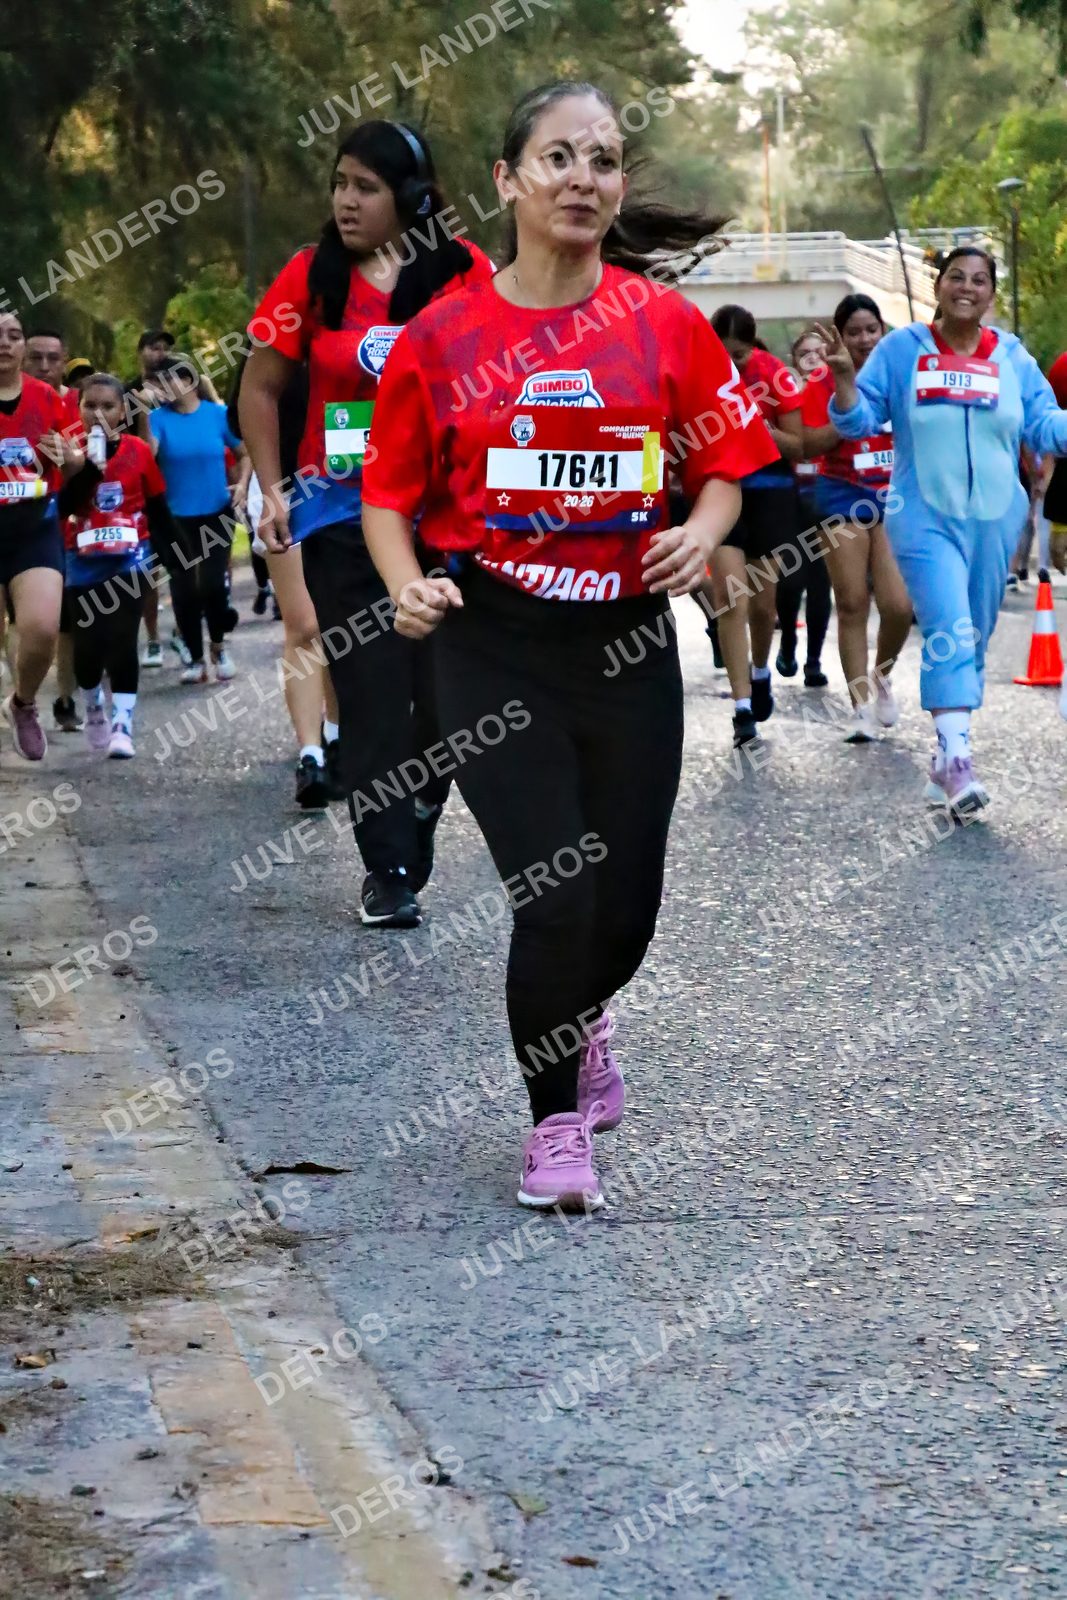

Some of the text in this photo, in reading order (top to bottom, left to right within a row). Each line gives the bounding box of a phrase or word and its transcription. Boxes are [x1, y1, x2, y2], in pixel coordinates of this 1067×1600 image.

[532, 379, 584, 394] BIMBO
[943, 372, 972, 387] 1913
[538, 453, 619, 488] 17641
[631, 511, 648, 522] 5K
[94, 527, 122, 541] 2255
